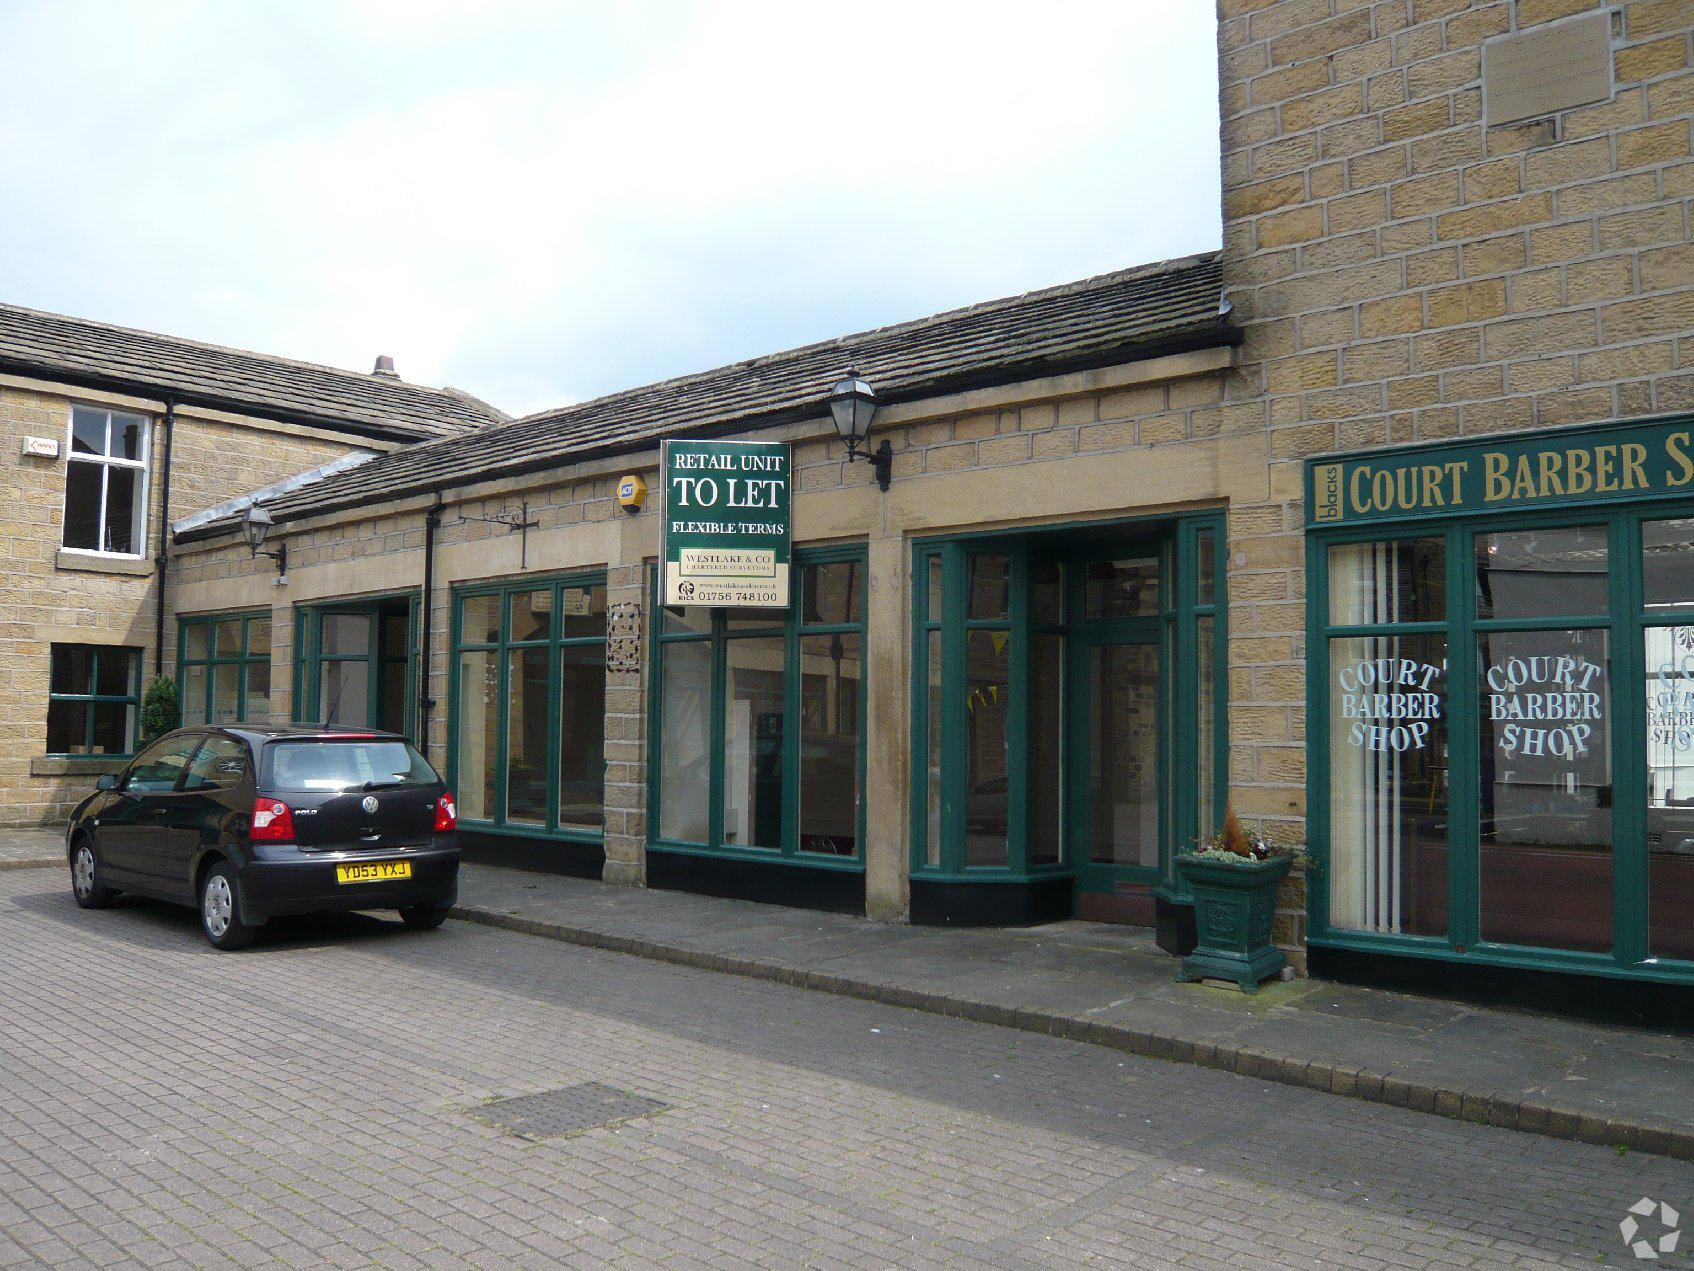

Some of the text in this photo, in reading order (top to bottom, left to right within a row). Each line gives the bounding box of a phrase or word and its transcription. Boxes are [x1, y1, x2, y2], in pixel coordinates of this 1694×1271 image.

[674, 454, 784, 471] RETAIL UNIT
[673, 477, 784, 508] TO LET
[1318, 466, 1338, 519] blacks
[1351, 461, 1468, 513] COURT
[1483, 443, 1650, 501] BARBER
[672, 521, 784, 535] FLEXIBLE TERMS
[686, 555, 742, 563] WESTLAKE
[755, 555, 771, 564] CO
[698, 592, 777, 601] 01756 748100
[1340, 658, 1440, 691] COURT
[1487, 656, 1601, 691] COURT
[1341, 693, 1441, 719] BARBER
[1488, 692, 1602, 720] BARBER
[1346, 721, 1429, 752] SHOP
[1498, 723, 1591, 756] SHOP
[343, 864, 378, 879] YD53
